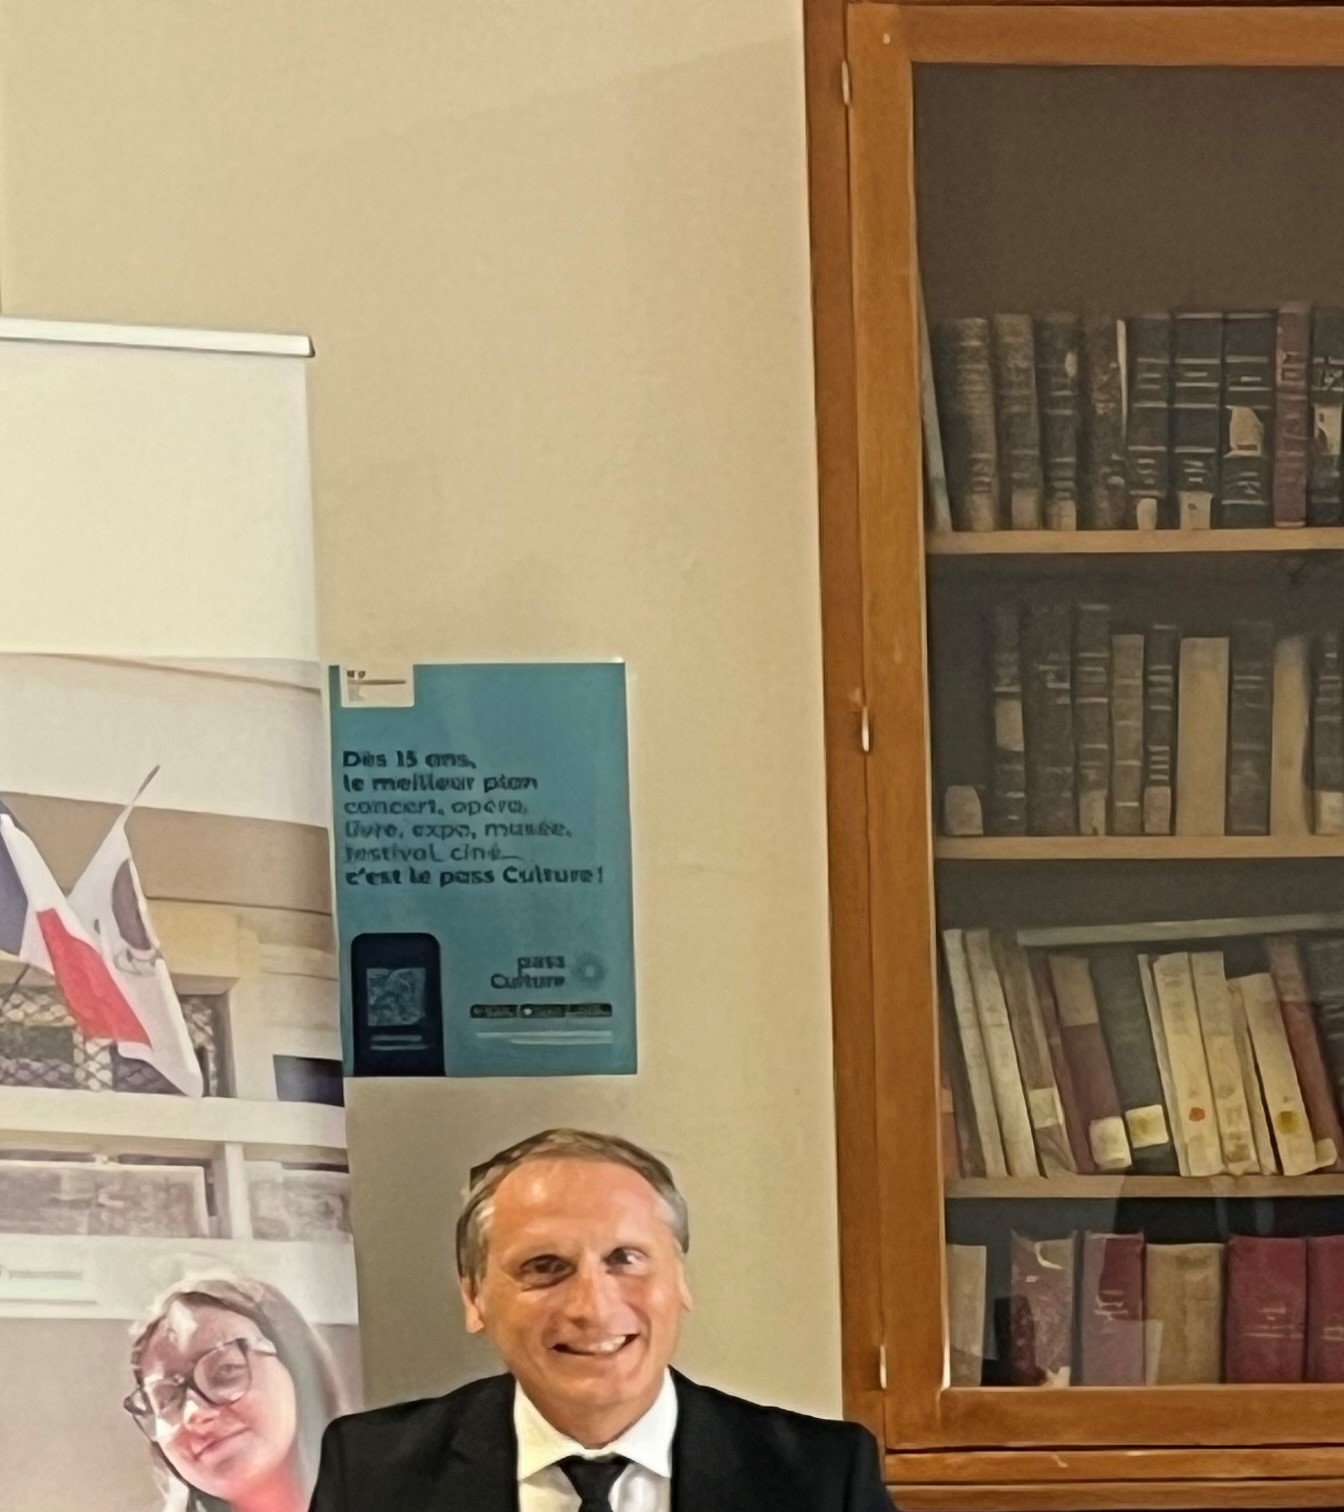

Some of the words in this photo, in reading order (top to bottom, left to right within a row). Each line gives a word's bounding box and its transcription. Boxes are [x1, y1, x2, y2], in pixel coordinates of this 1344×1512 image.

[343, 774, 364, 792] le
[372, 772, 475, 791] meilleur
[483, 774, 538, 793] plan
[345, 867, 402, 886] c'est
[409, 866, 431, 885] le
[440, 870, 495, 888] pass
